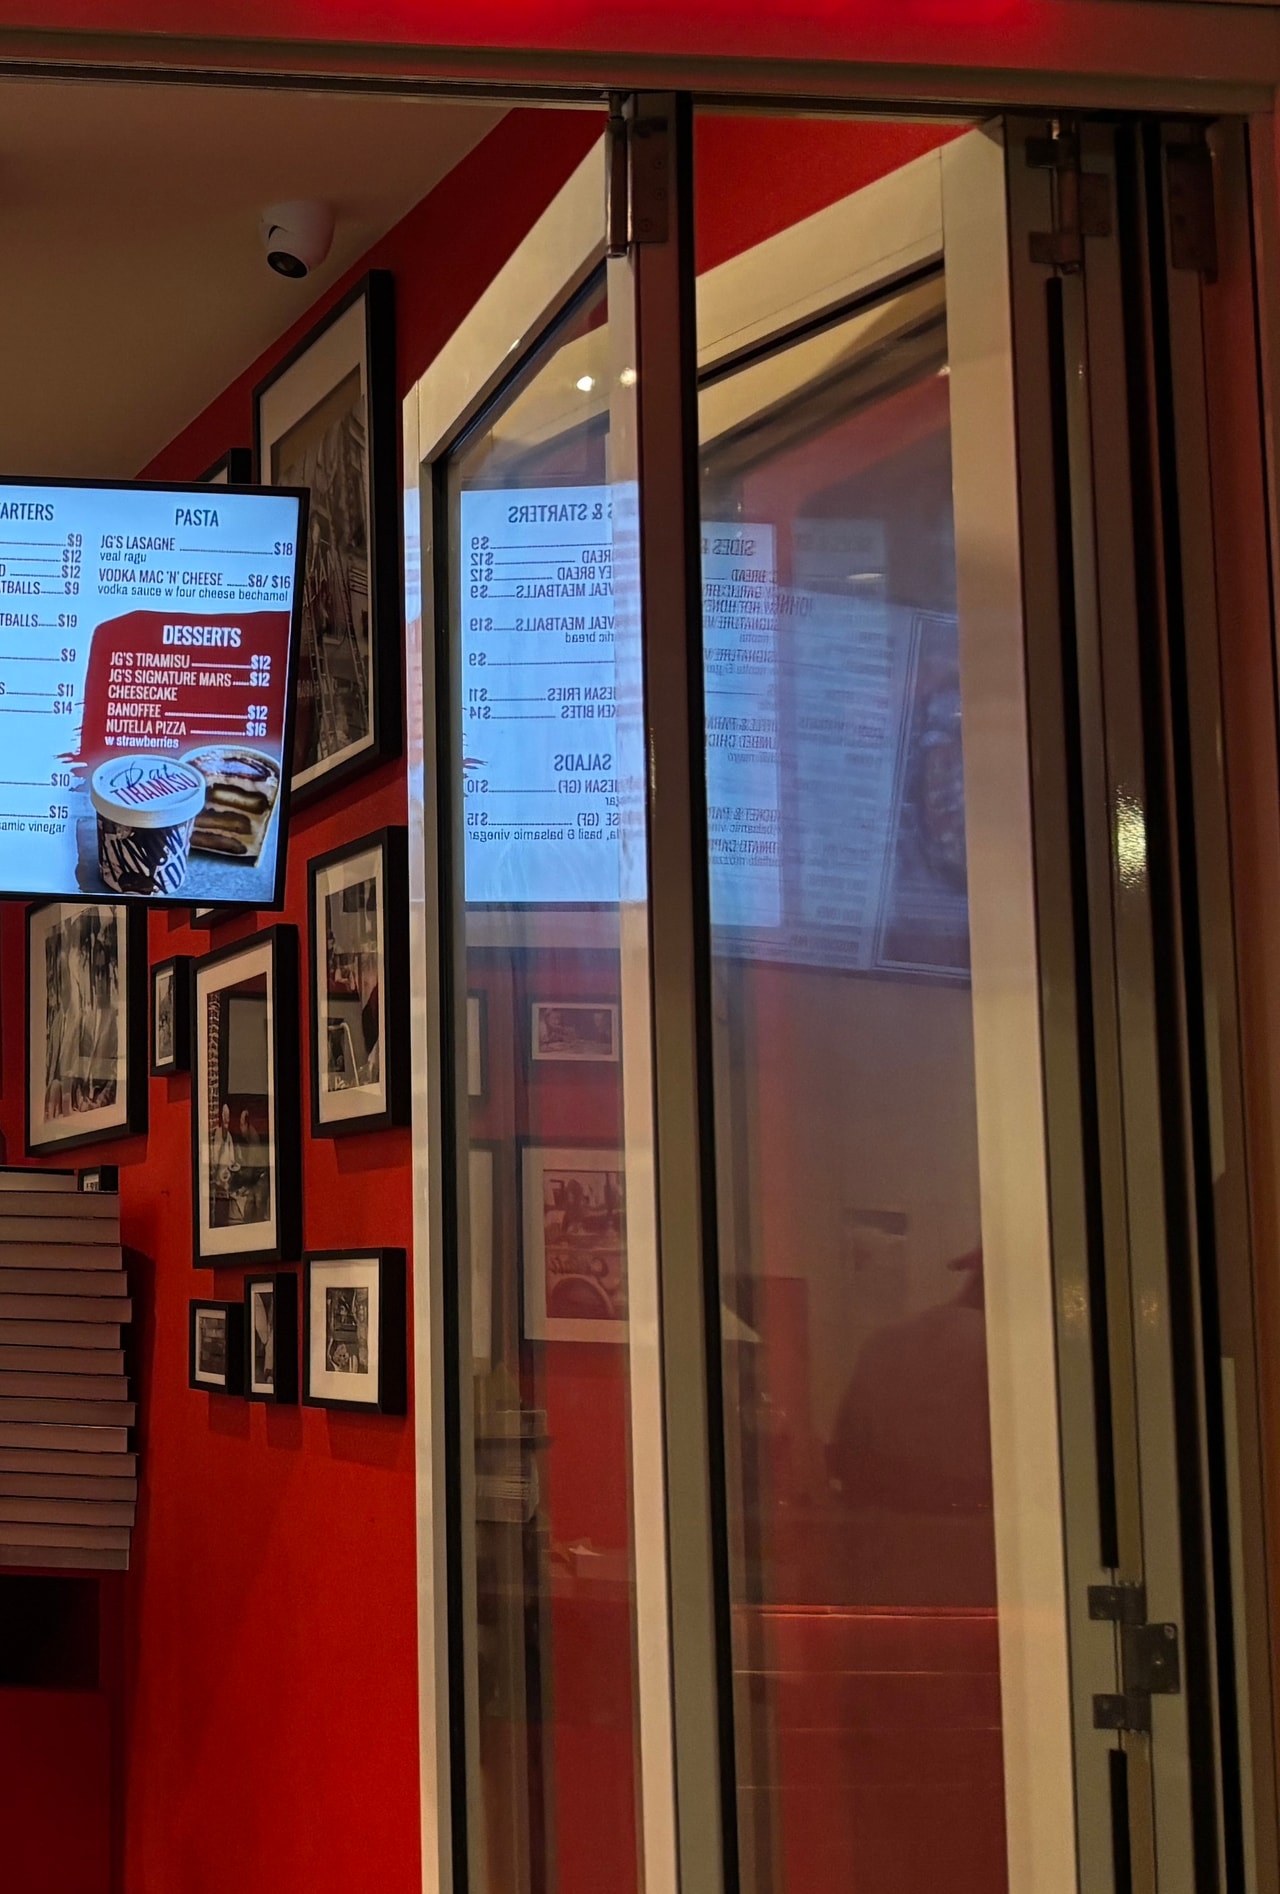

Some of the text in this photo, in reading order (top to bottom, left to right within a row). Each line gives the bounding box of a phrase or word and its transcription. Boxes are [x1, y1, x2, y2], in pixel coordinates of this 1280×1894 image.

[174, 507, 219, 527] PASTA
[66, 532, 82, 548] $9
[99, 533, 293, 556] JG'S LASAGNE $18
[99, 549, 147, 565] veal ragu
[60, 564, 81, 579] $12
[162, 624, 242, 648] DESSERTS
[60, 647, 76, 662] $9
[109, 651, 271, 670] JG'S TIRAMISU $12
[107, 684, 178, 701] CHEESECAKE
[106, 701, 268, 720] BANOFFEE $12
[105, 718, 153, 734] NUTELLA
[154, 720, 186, 736] PIZZA
[104, 734, 179, 749] w strawberries
[48, 804, 69, 819] $15
